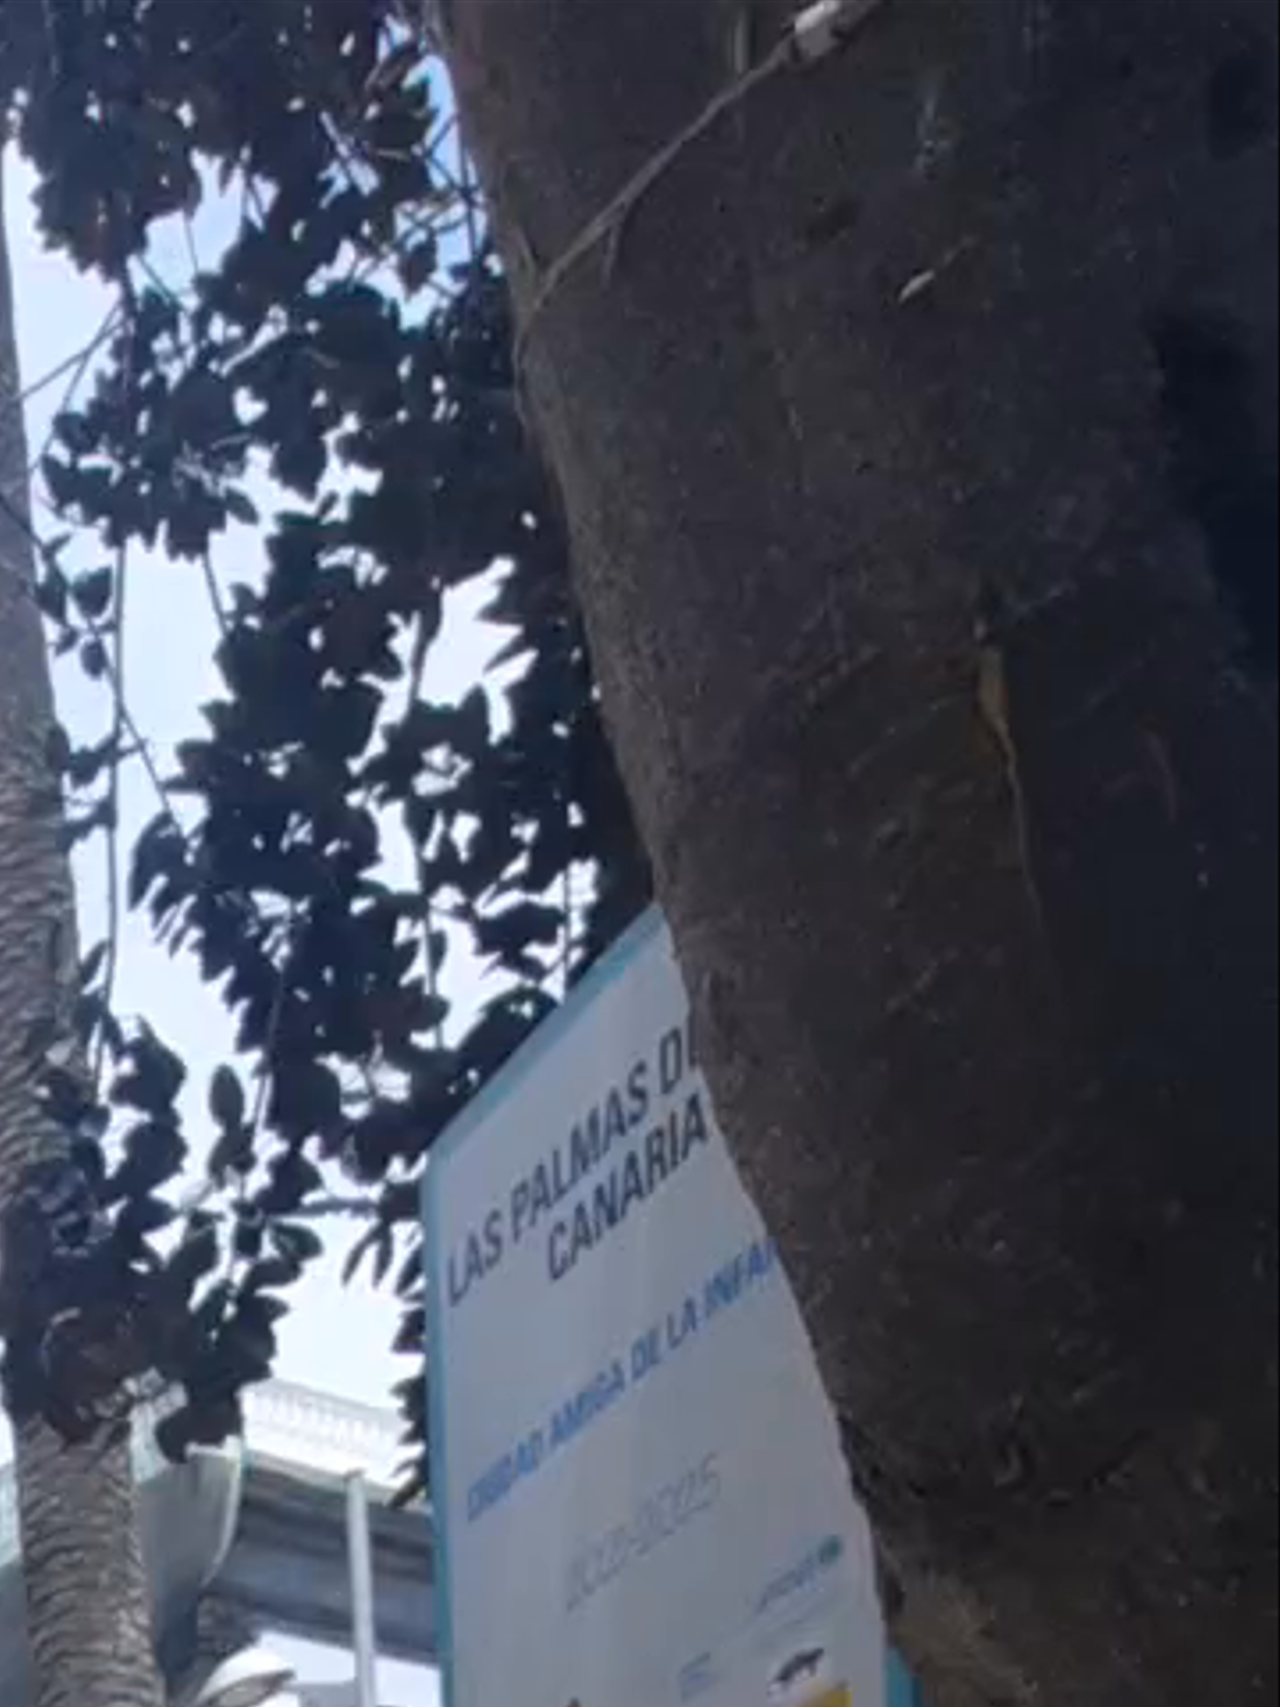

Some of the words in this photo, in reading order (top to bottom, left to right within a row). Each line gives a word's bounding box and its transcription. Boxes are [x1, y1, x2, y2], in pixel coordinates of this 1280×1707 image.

[447, 1208, 504, 1308] LAS
[511, 1059, 649, 1245] PALMAS
[547, 1089, 709, 1283] CANARIA
[630, 1326, 661, 1382] DE
[665, 1298, 698, 1350] LA
